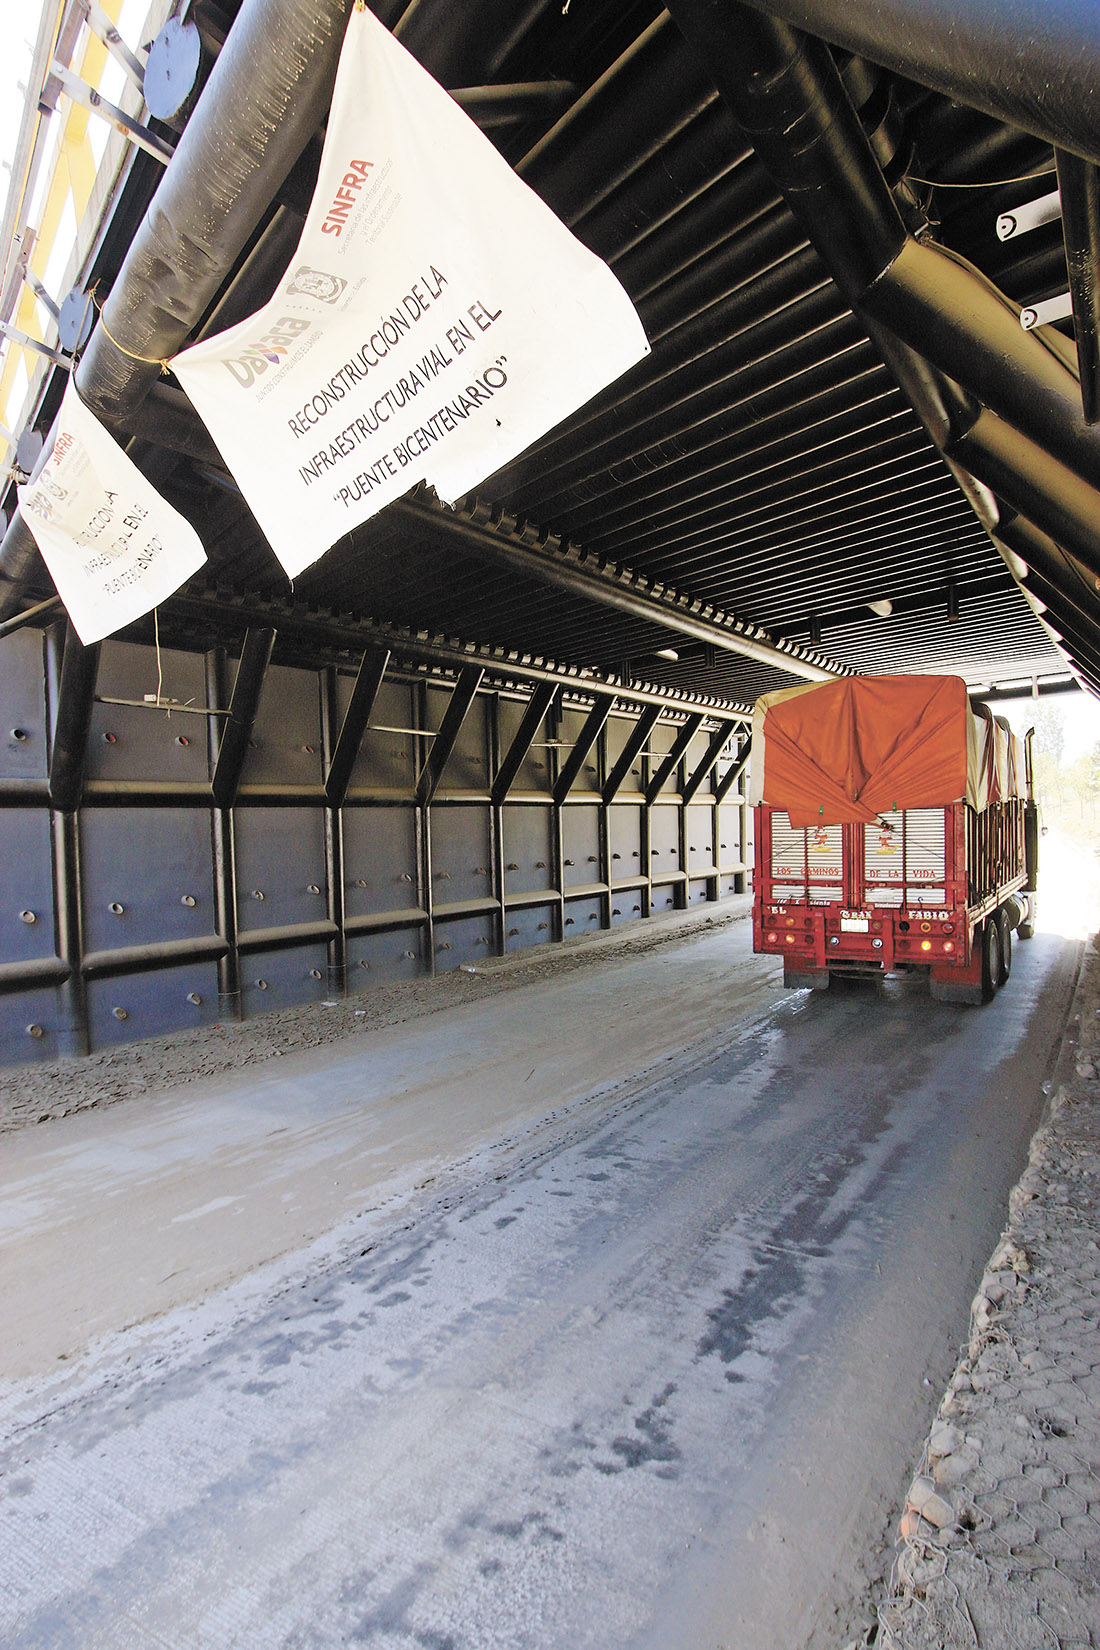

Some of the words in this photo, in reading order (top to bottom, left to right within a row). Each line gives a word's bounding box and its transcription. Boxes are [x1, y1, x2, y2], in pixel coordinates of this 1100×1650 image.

[321, 159, 374, 237] SINFRA
[288, 316, 410, 438] RECONSTRUCCIÓN
[402, 295, 430, 321] DE
[422, 265, 448, 299] LA
[298, 372, 427, 485] INFRAESTRUCTURA
[416, 344, 453, 386] VIAL
[446, 319, 475, 355] EN
[469, 300, 502, 332] EL
[333, 454, 400, 508] “PUENTE
[395, 355, 508, 467] BICENTENARIO”
[776, 866, 791, 875] LOS
[800, 867, 839, 876] CAMINOS
[869, 869, 881, 878] DE
[888, 869, 899, 878] LA
[912, 869, 936, 878] VIDA
